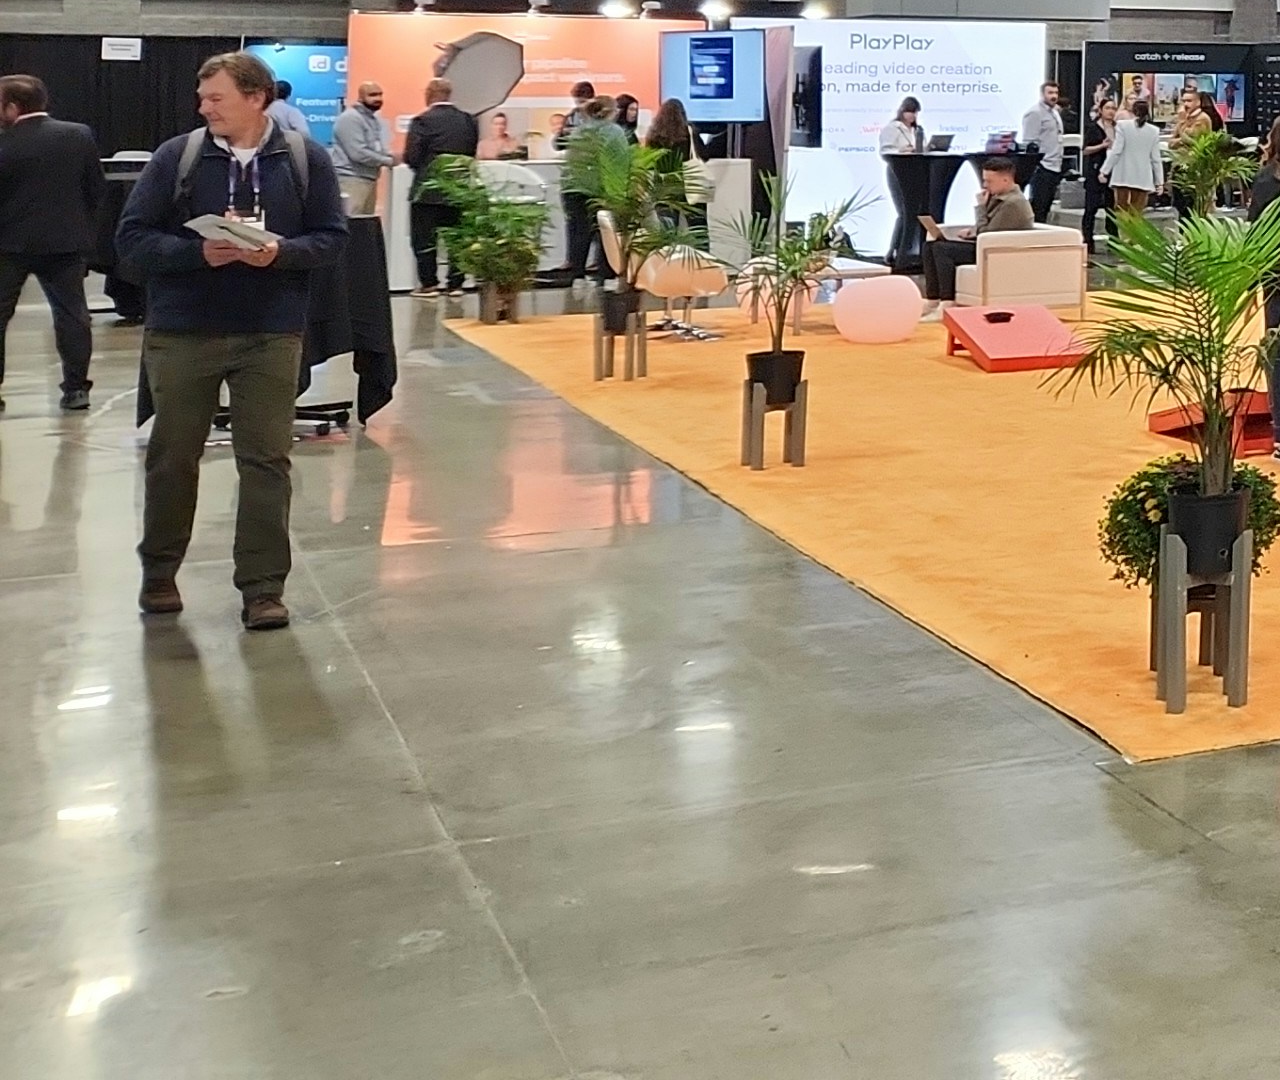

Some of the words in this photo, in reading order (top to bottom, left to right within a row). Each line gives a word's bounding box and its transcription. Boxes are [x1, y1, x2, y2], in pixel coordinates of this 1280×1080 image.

[850, 33, 935, 51] PlayPlay
[1134, 52, 1161, 61] catch
[1172, 52, 1206, 61] release
[823, 62, 878, 78] eading
[883, 62, 926, 75] video
[930, 63, 993, 76] creation
[846, 80, 890, 93] made
[896, 80, 917, 93] for
[921, 80, 1002, 96] enterprise.
